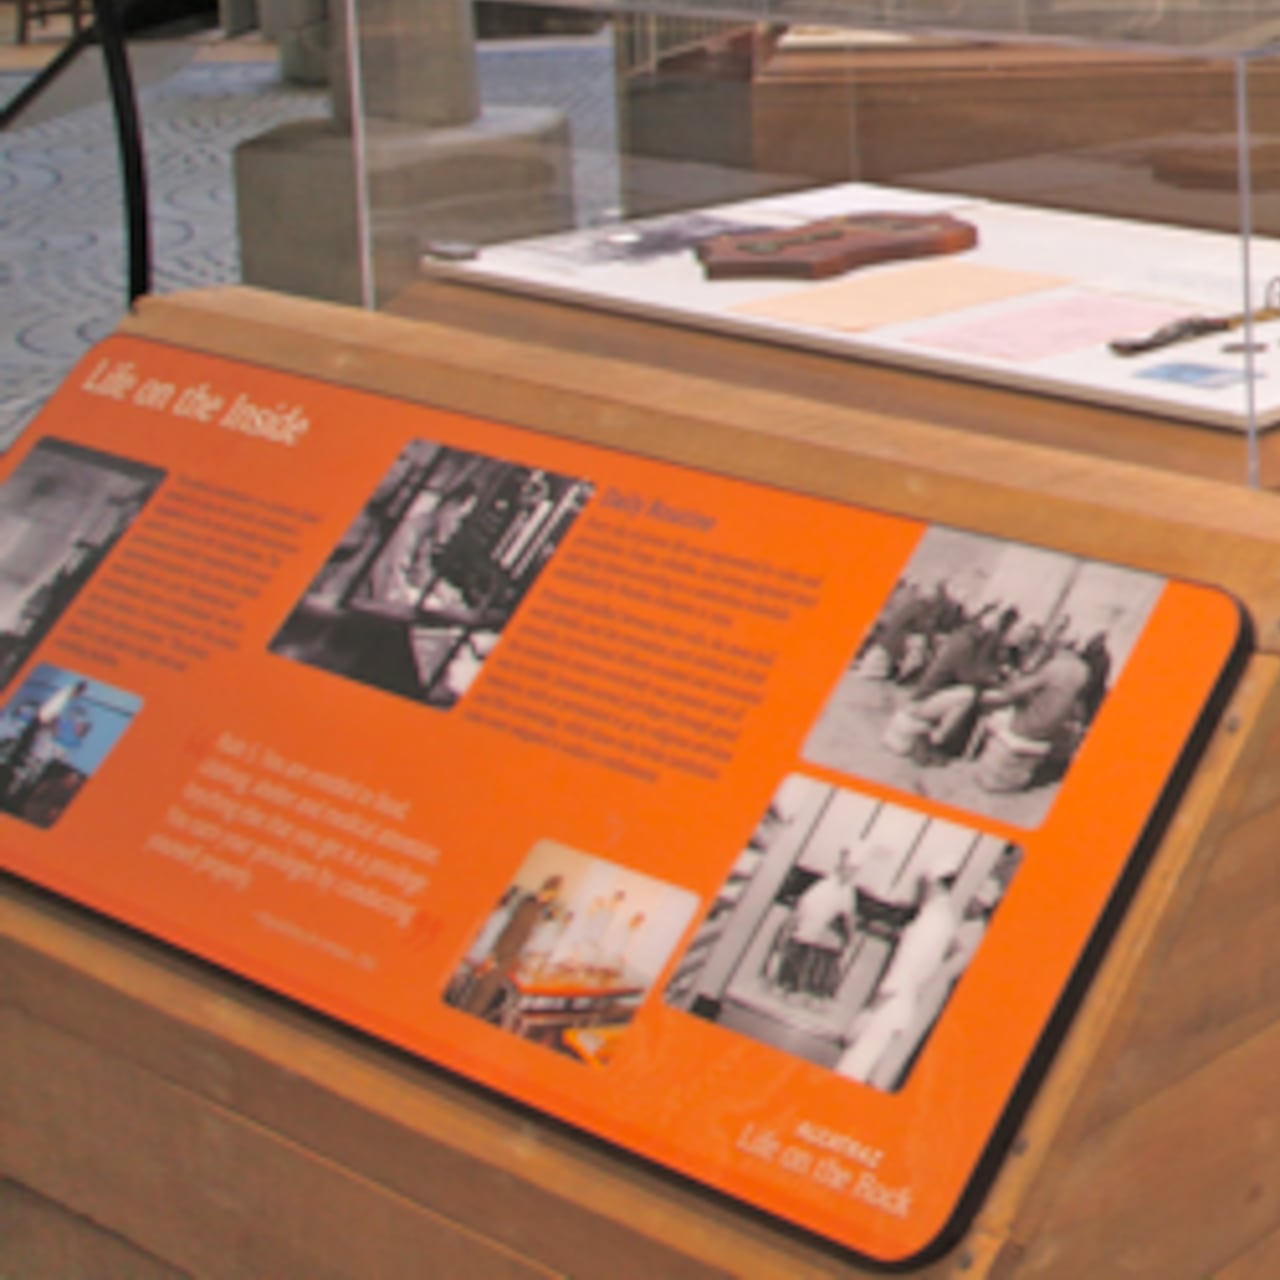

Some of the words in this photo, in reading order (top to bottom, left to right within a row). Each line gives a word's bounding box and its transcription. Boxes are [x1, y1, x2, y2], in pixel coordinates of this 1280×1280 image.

[83, 358, 136, 400] Life
[132, 377, 176, 412] on
[172, 381, 225, 424] the
[220, 393, 309, 446] Inside
[736, 1121, 781, 1164] Life
[778, 1145, 815, 1176] on
[812, 1156, 853, 1195] the
[851, 1171, 913, 1219] Rock
